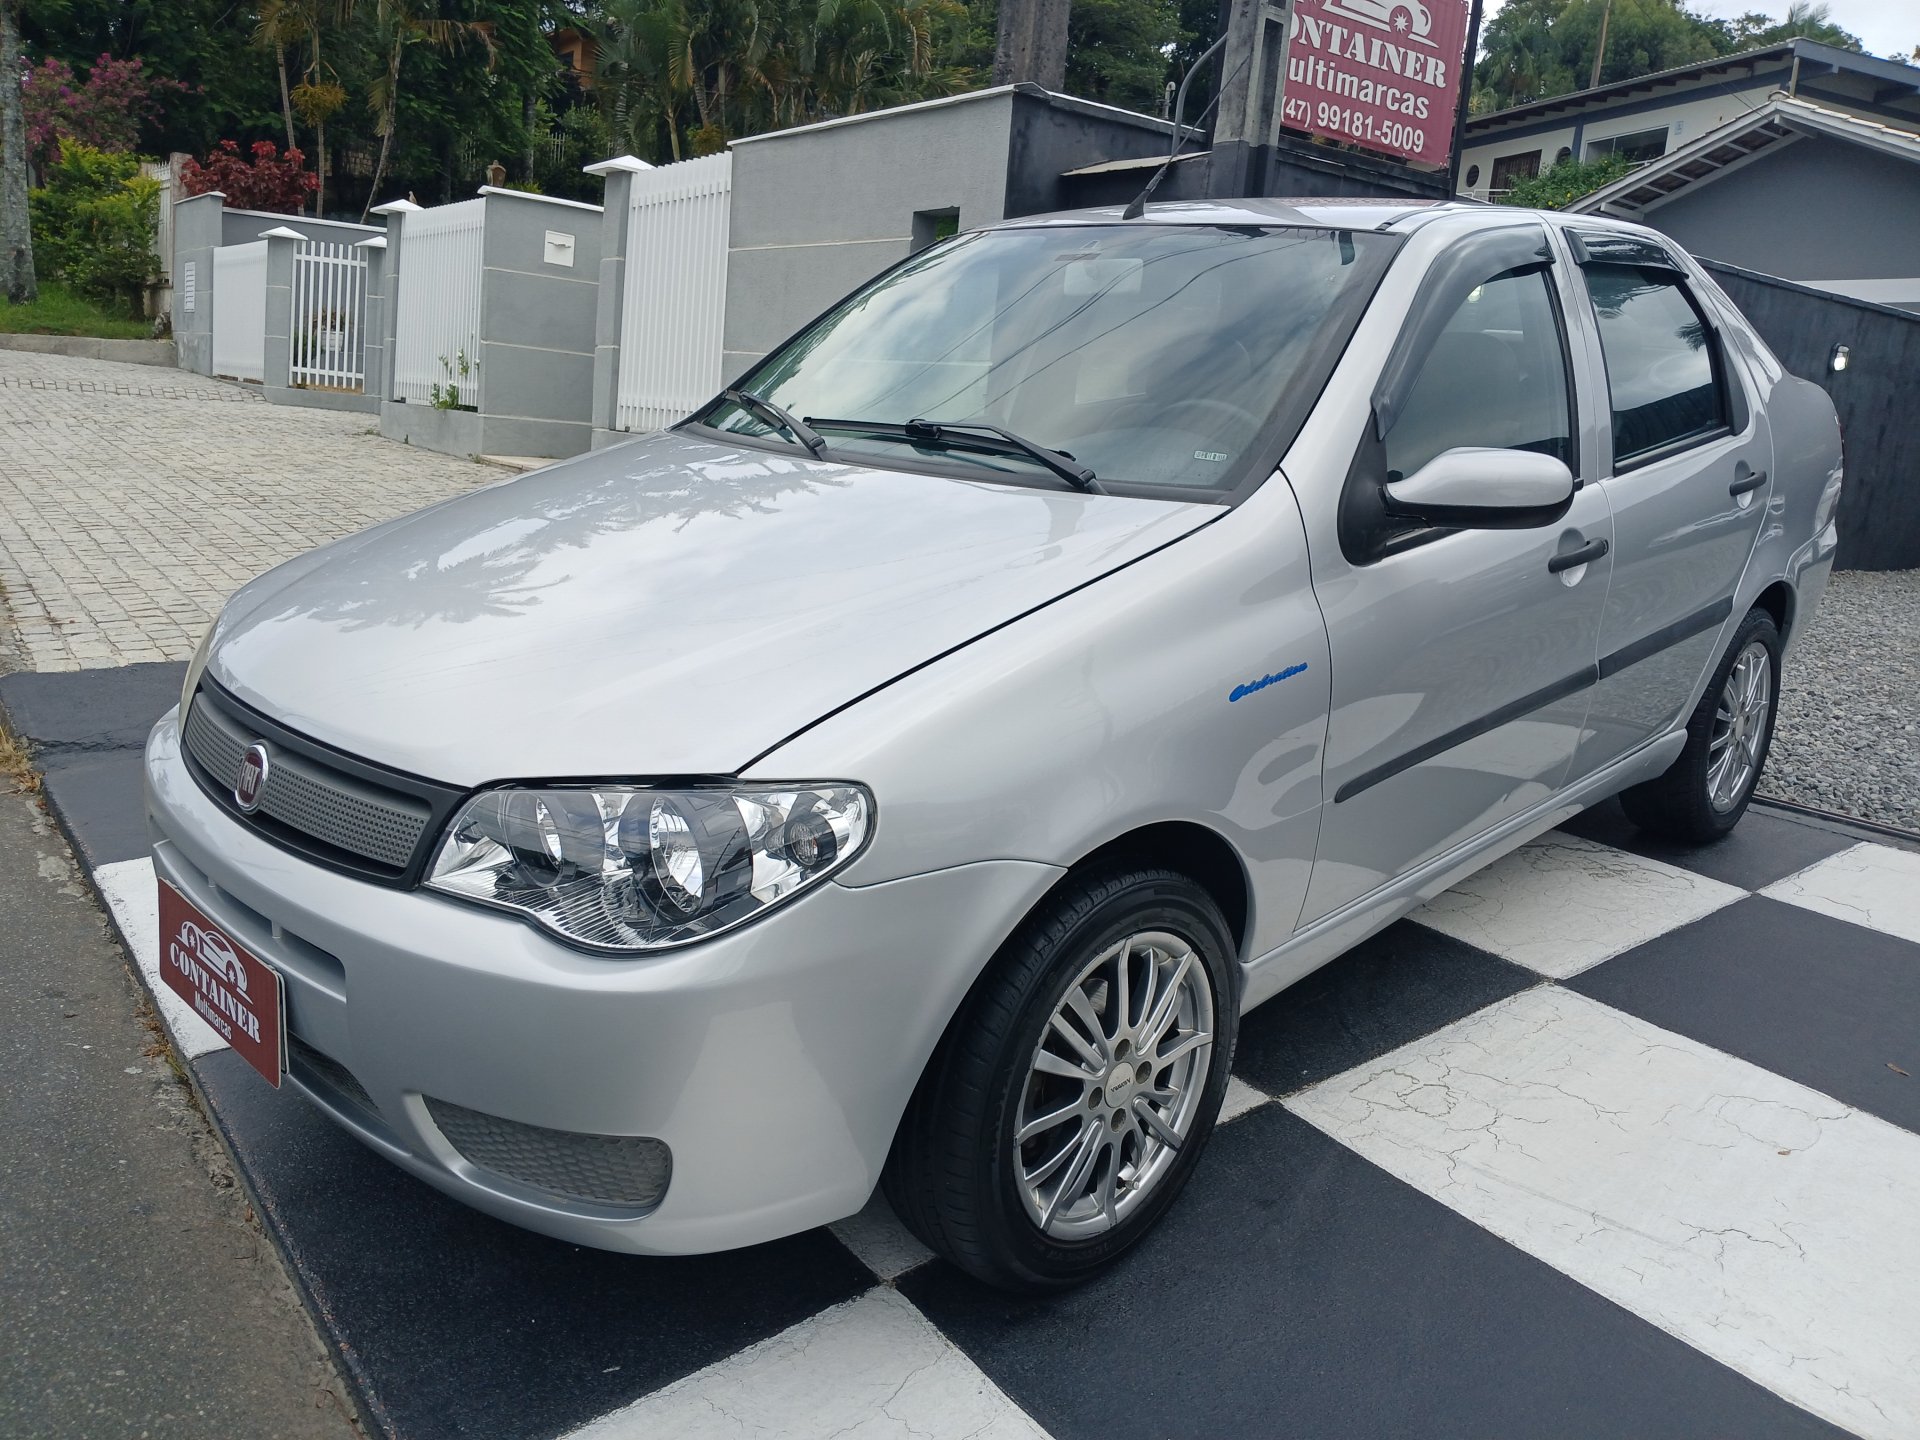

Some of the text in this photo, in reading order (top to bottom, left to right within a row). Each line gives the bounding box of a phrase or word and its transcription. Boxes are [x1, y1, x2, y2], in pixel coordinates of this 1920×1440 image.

[1289, 11, 1446, 88] ONTAINER
[1289, 55, 1430, 119] ultimarcas
[1317, 101, 1424, 153] 99181-5009
[170, 942, 261, 1044] CONTAINER
[194, 990, 232, 1040] Multimarcas
